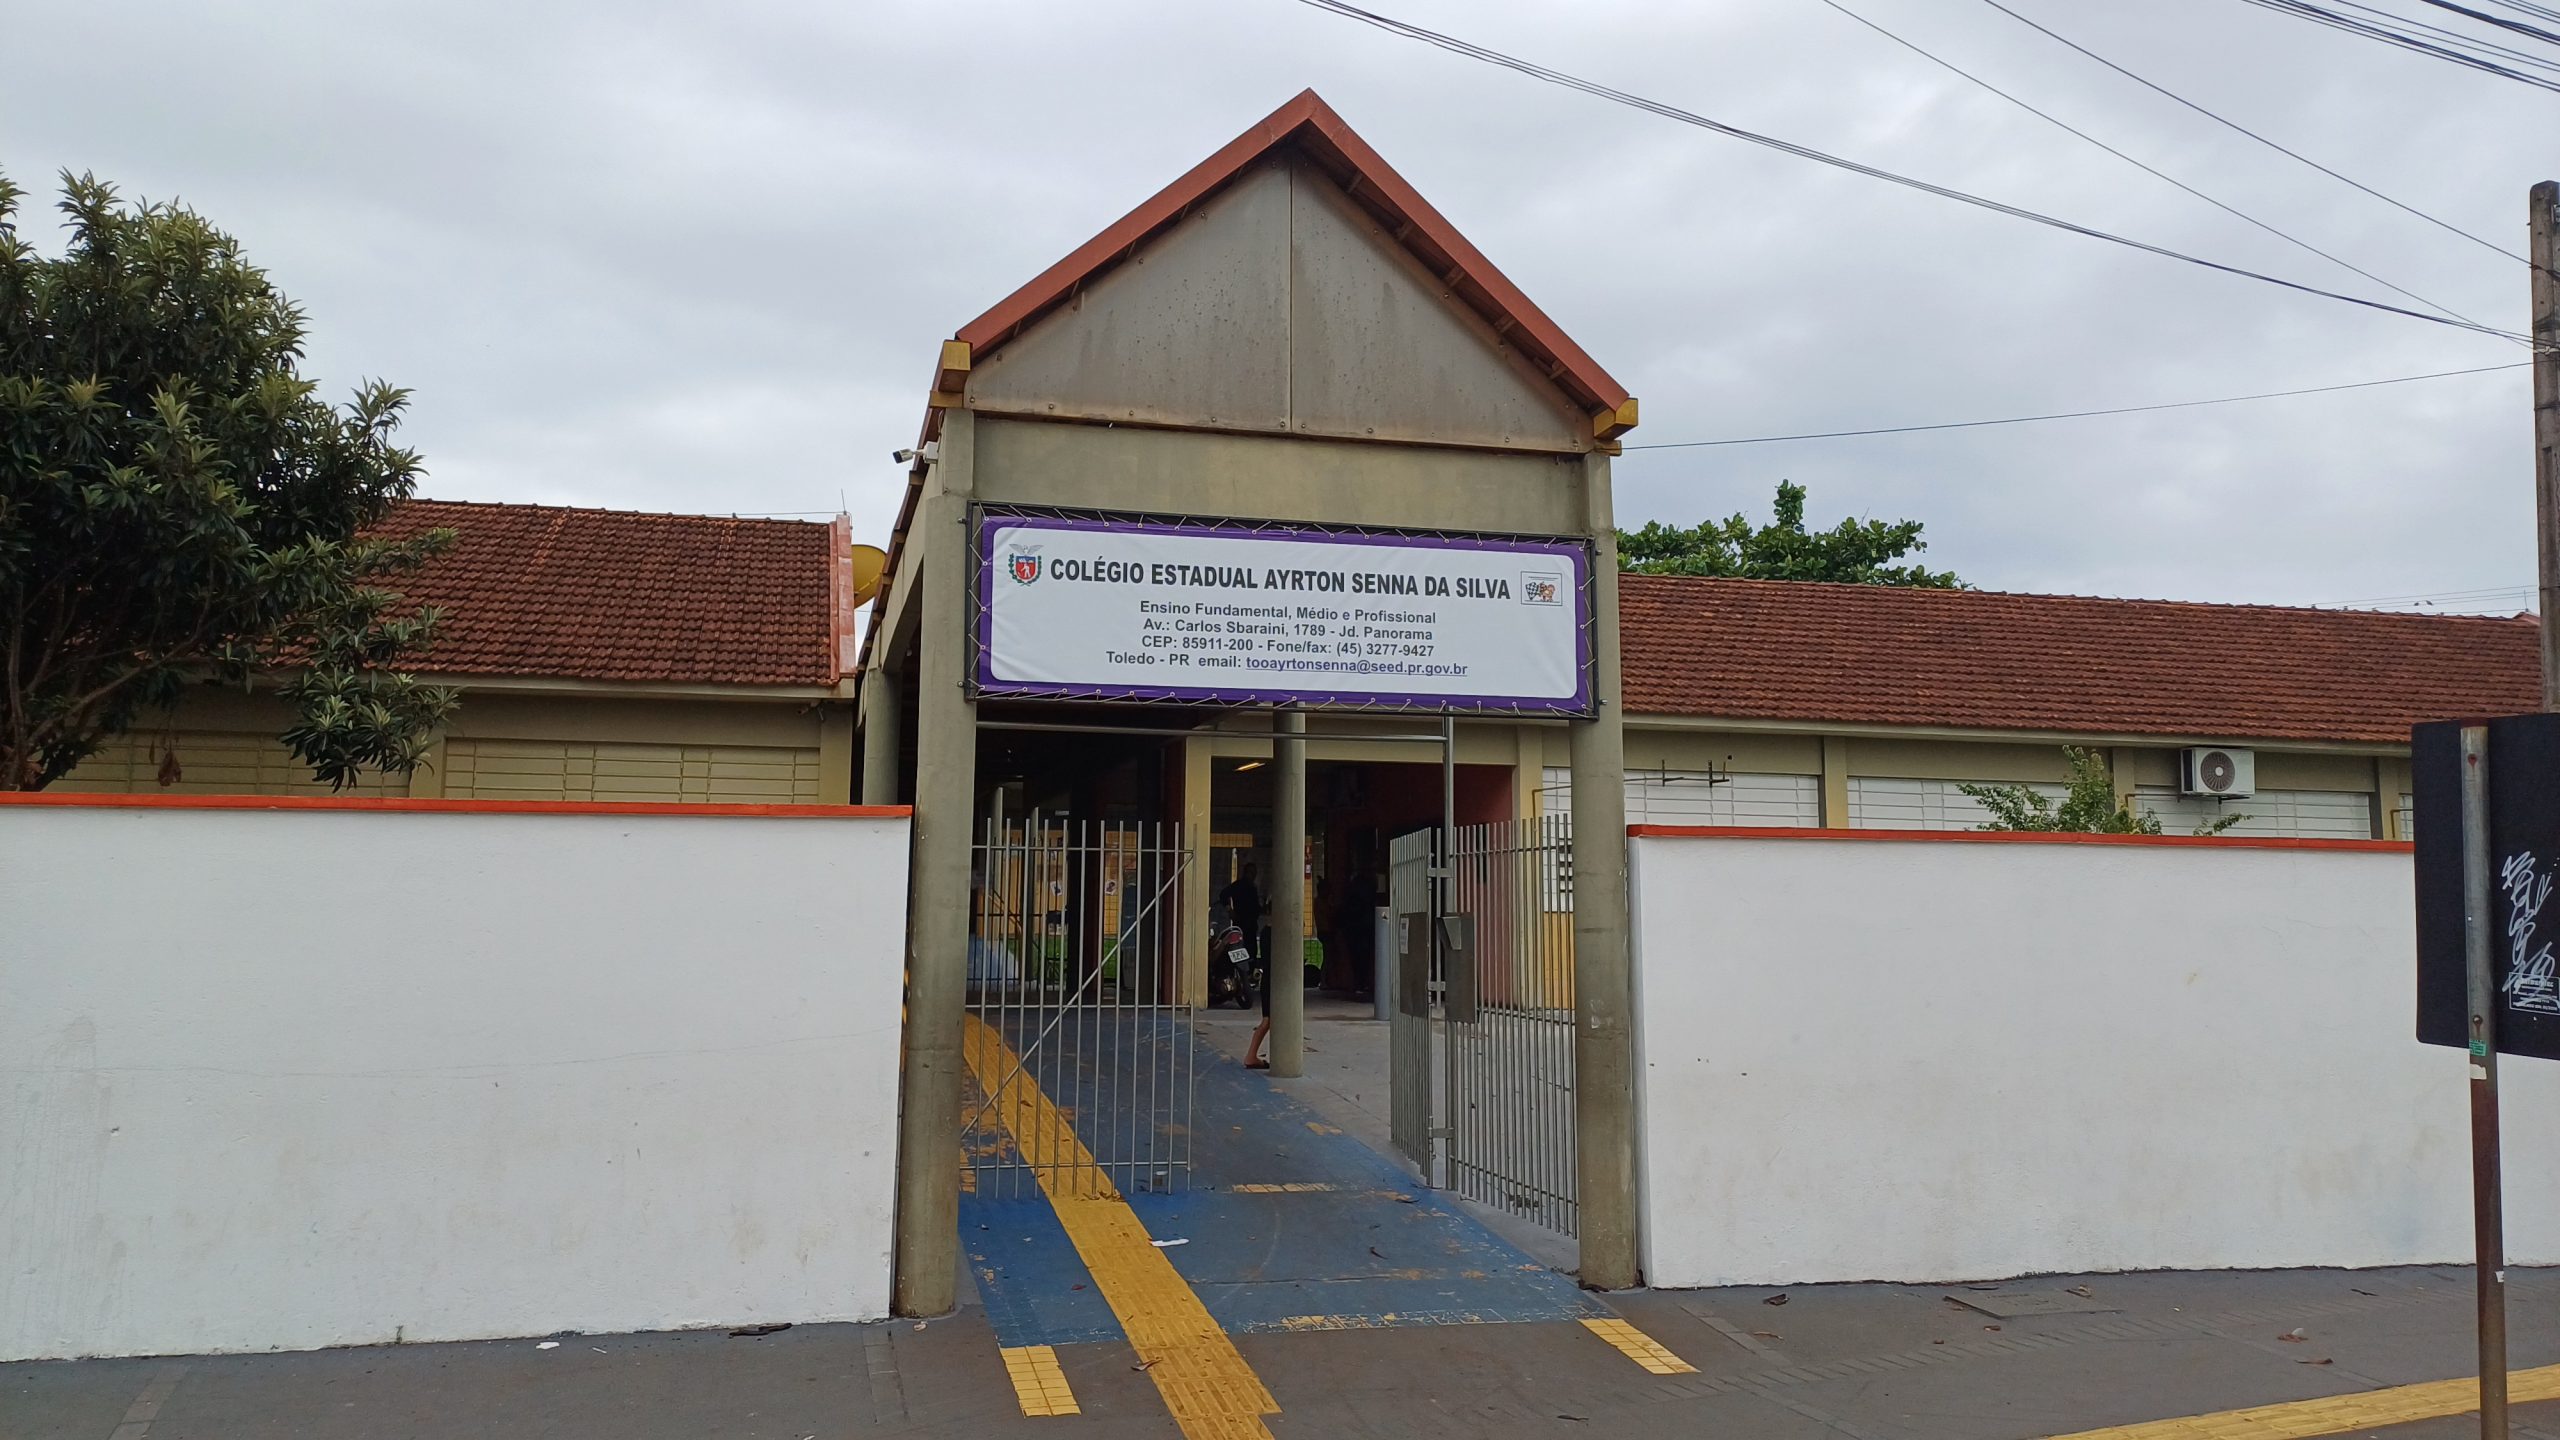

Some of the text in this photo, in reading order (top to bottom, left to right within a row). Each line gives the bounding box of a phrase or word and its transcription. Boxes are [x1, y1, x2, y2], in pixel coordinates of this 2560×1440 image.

[1050, 555, 1511, 600] COLÉGIO ESTADUAL AYRTON SENNA DA SILVA
[1140, 600, 1436, 624] Ensino Fundamental, Médio e Profissional
[1143, 617, 1170, 631] Av.:
[1174, 618, 1222, 633] Carlos
[1226, 620, 1289, 637] Sbaraini,
[1293, 623, 1326, 637] 1789
[1338, 625, 1359, 638] Jd.
[1363, 626, 1433, 641] Panorama
[1141, 634, 1178, 649] CEP:
[1182, 636, 1254, 651] 85911-200
[1267, 639, 1332, 654] Fone/fax:
[1336, 641, 1362, 658] (45)
[1366, 643, 1435, 657] 3277-9427
[1105, 650, 1155, 665] Toledo
[1169, 653, 1190, 666] PR
[1198, 655, 1241, 668] email:
[1245, 656, 1468, 677] tooayrtonsenna@seed.pr.gov.br
